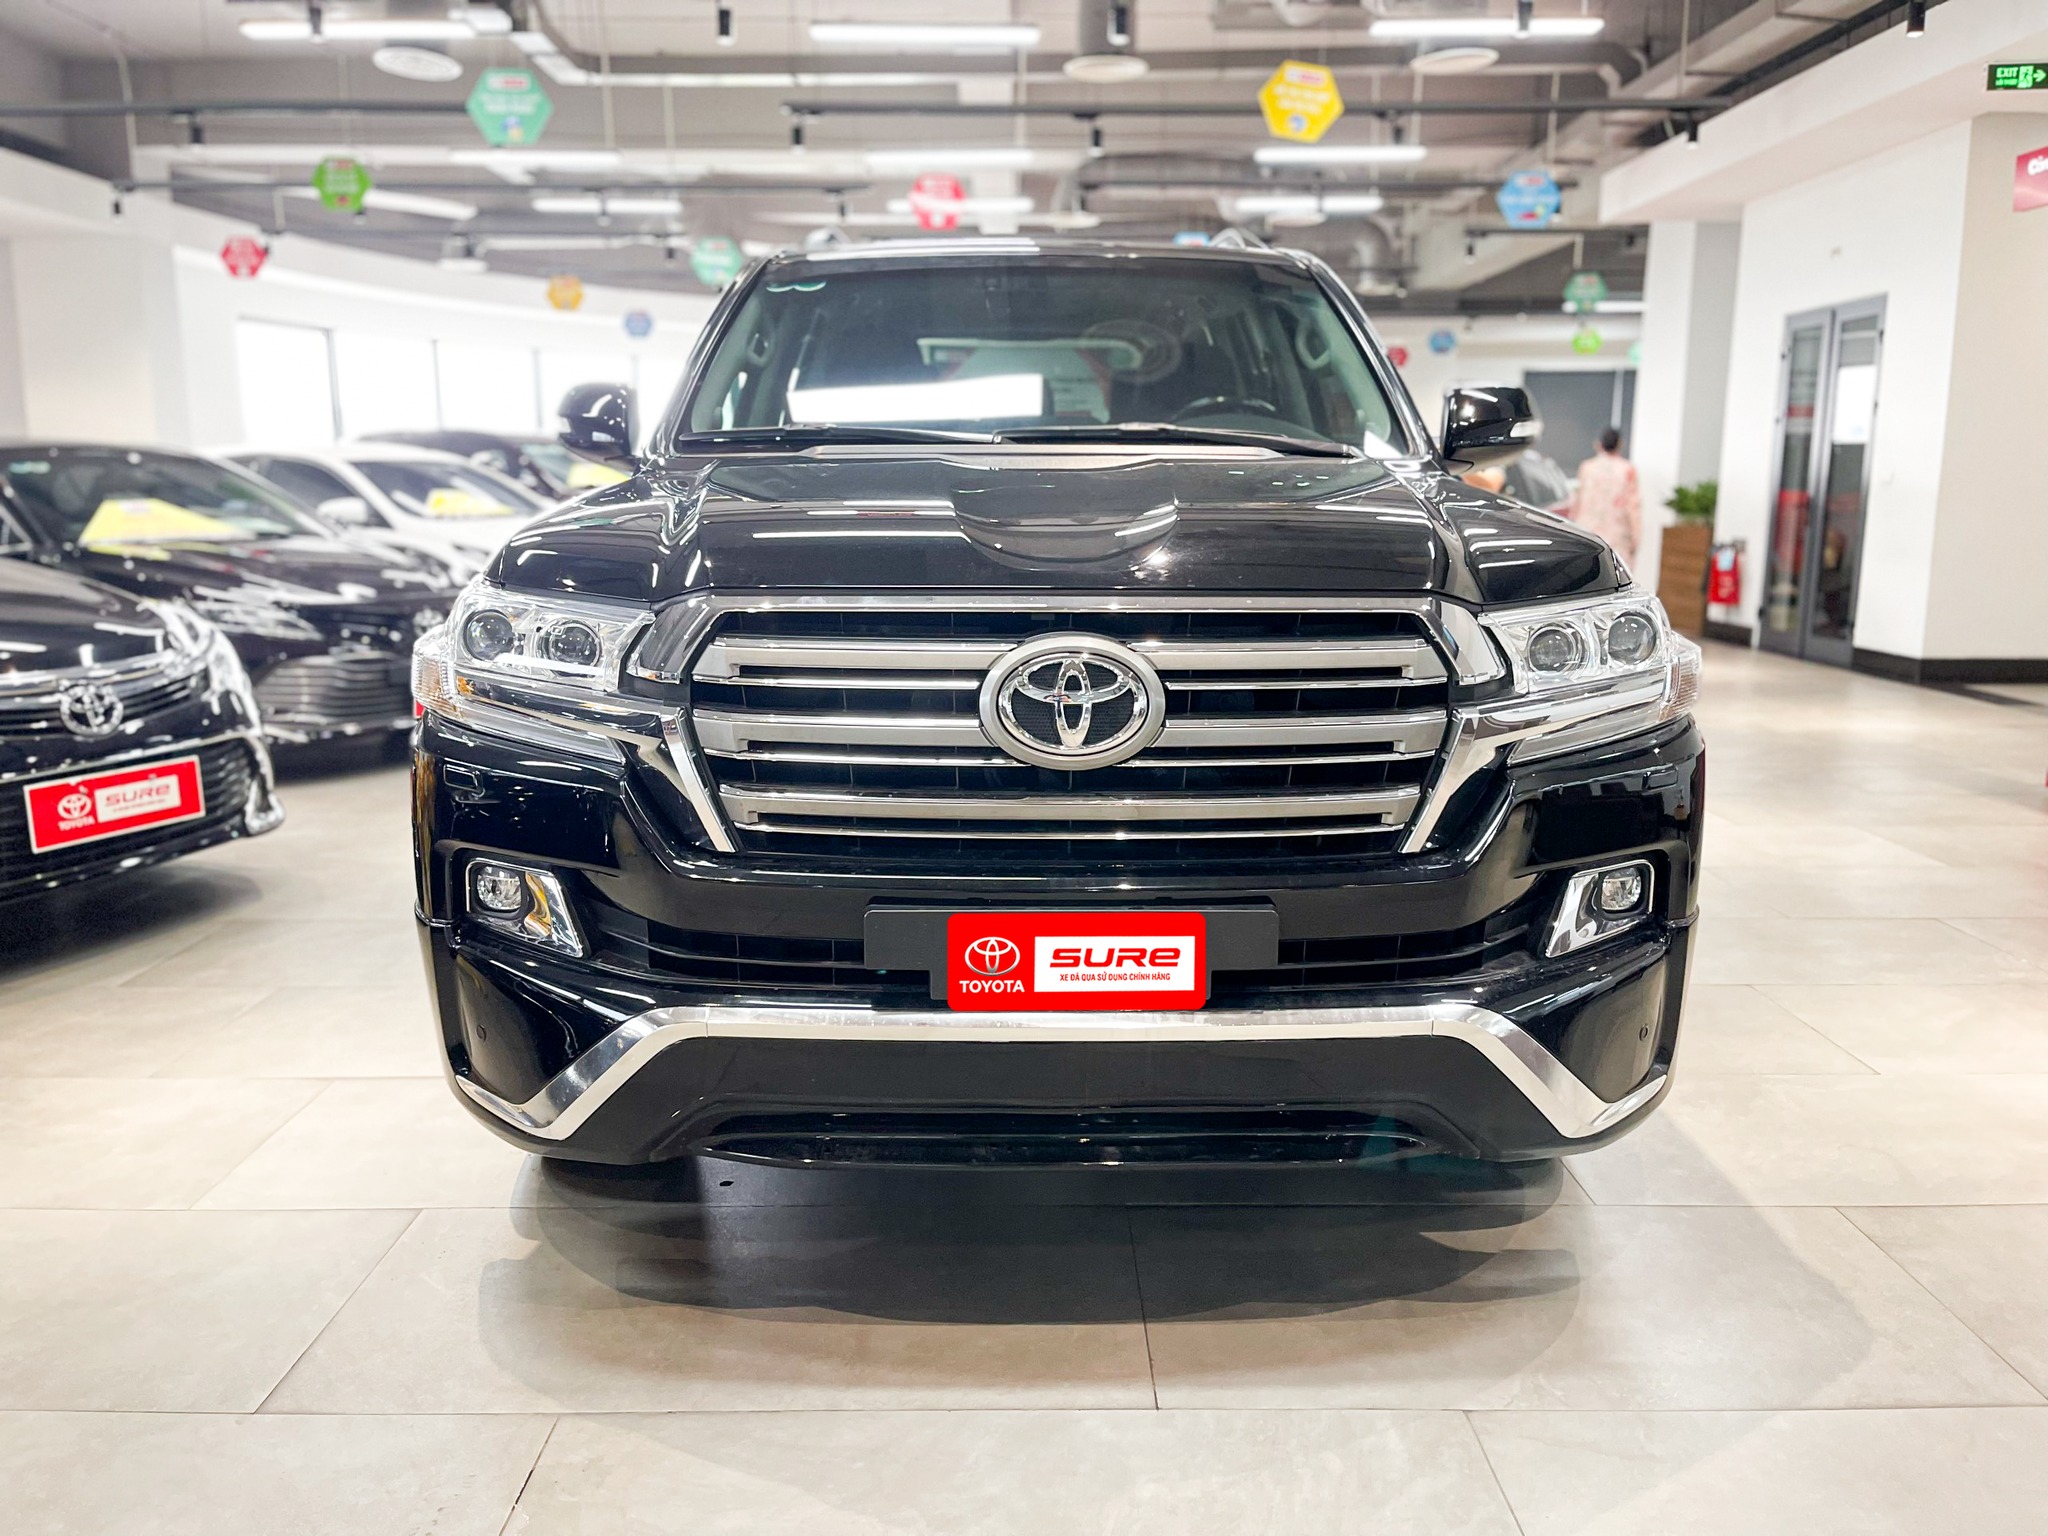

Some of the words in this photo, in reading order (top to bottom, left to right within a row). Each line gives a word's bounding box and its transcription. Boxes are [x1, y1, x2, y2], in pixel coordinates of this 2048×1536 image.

[1996, 67, 2018, 78] EXIT
[1081, 973, 1096, 981] QUA
[1129, 971, 1150, 981] CHÍNH
[959, 980, 1025, 993] TOYOTA
